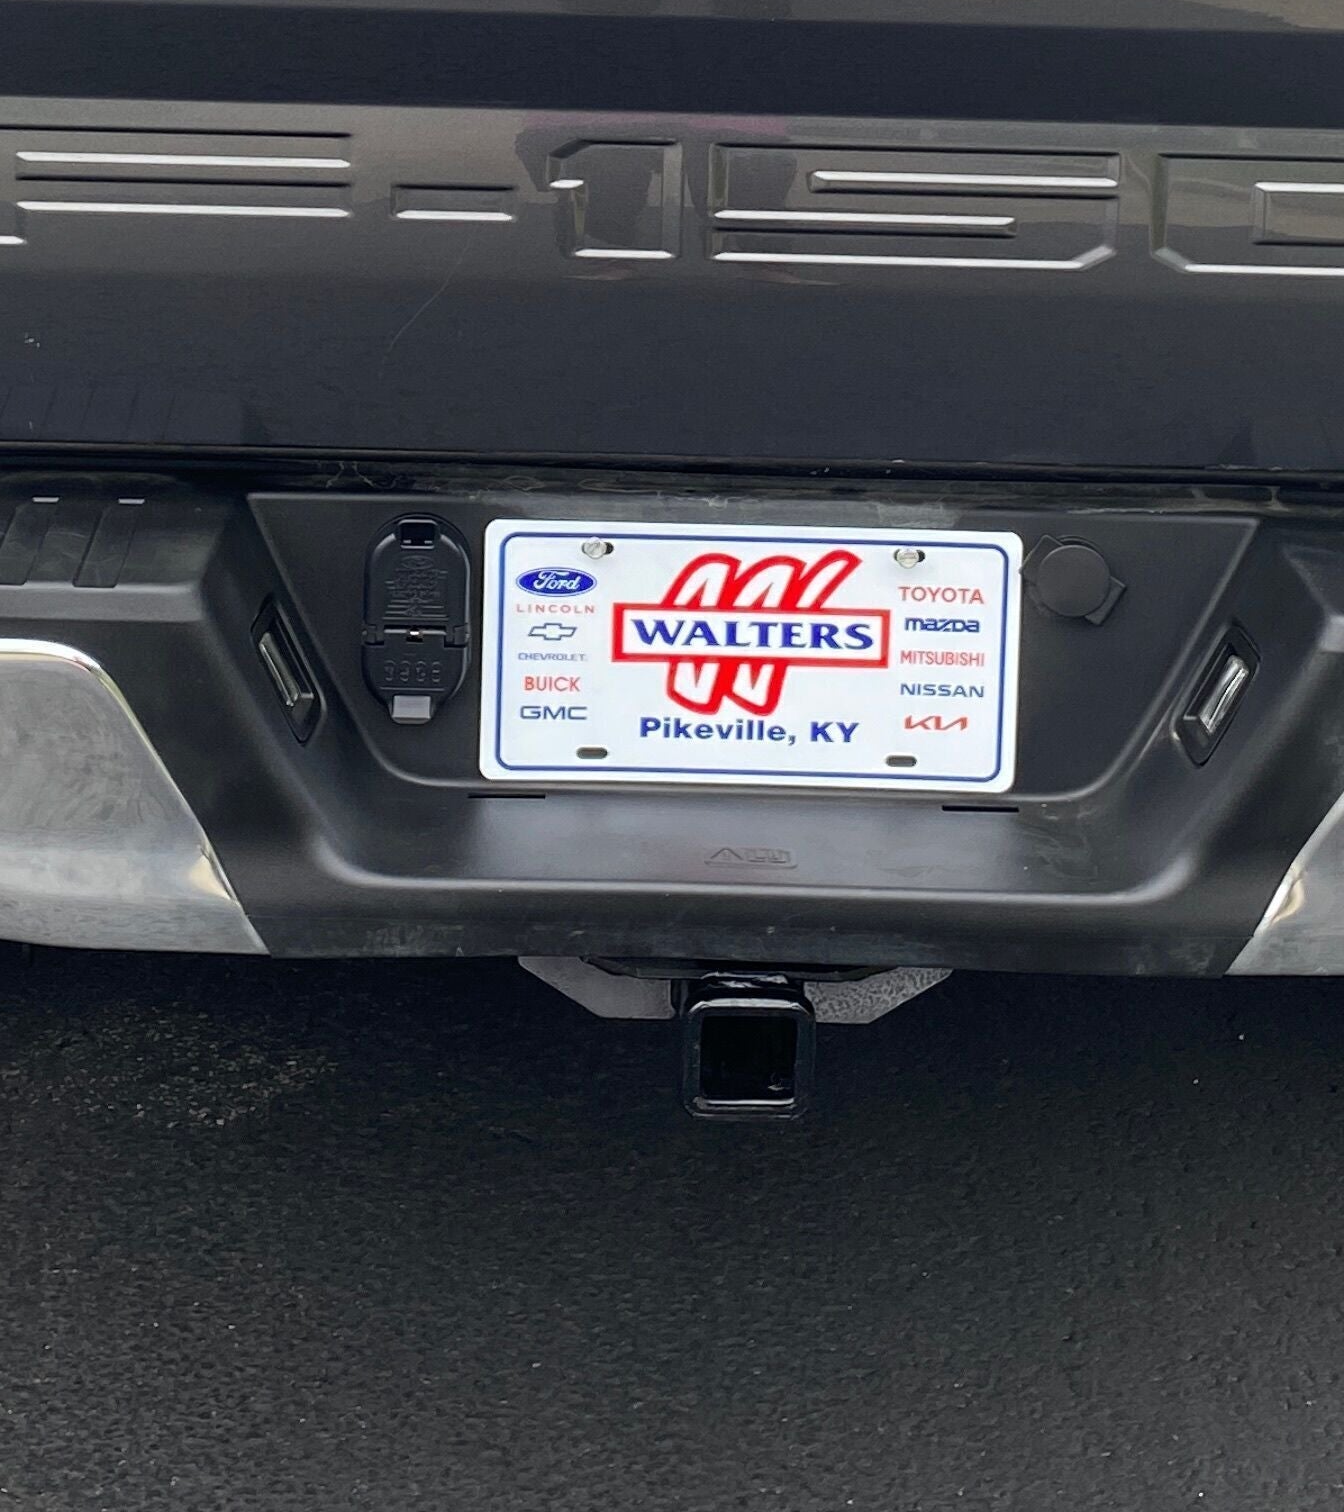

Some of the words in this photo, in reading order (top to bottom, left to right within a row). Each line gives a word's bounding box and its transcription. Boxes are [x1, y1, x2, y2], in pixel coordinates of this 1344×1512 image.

[533, 570, 582, 590] Ford
[898, 586, 985, 605] TOYOTA
[516, 603, 596, 614] LINCOLN
[630, 618, 875, 651] WALTERS
[518, 652, 588, 662] CHEVROLET
[900, 649, 985, 668] MITSUBISHI
[523, 675, 582, 693] BUICK
[900, 682, 985, 699] NISSAN
[520, 705, 588, 721] GMC
[639, 716, 797, 746] Pikeville,
[809, 720, 860, 744] KY
[904, 714, 969, 731] KIA
